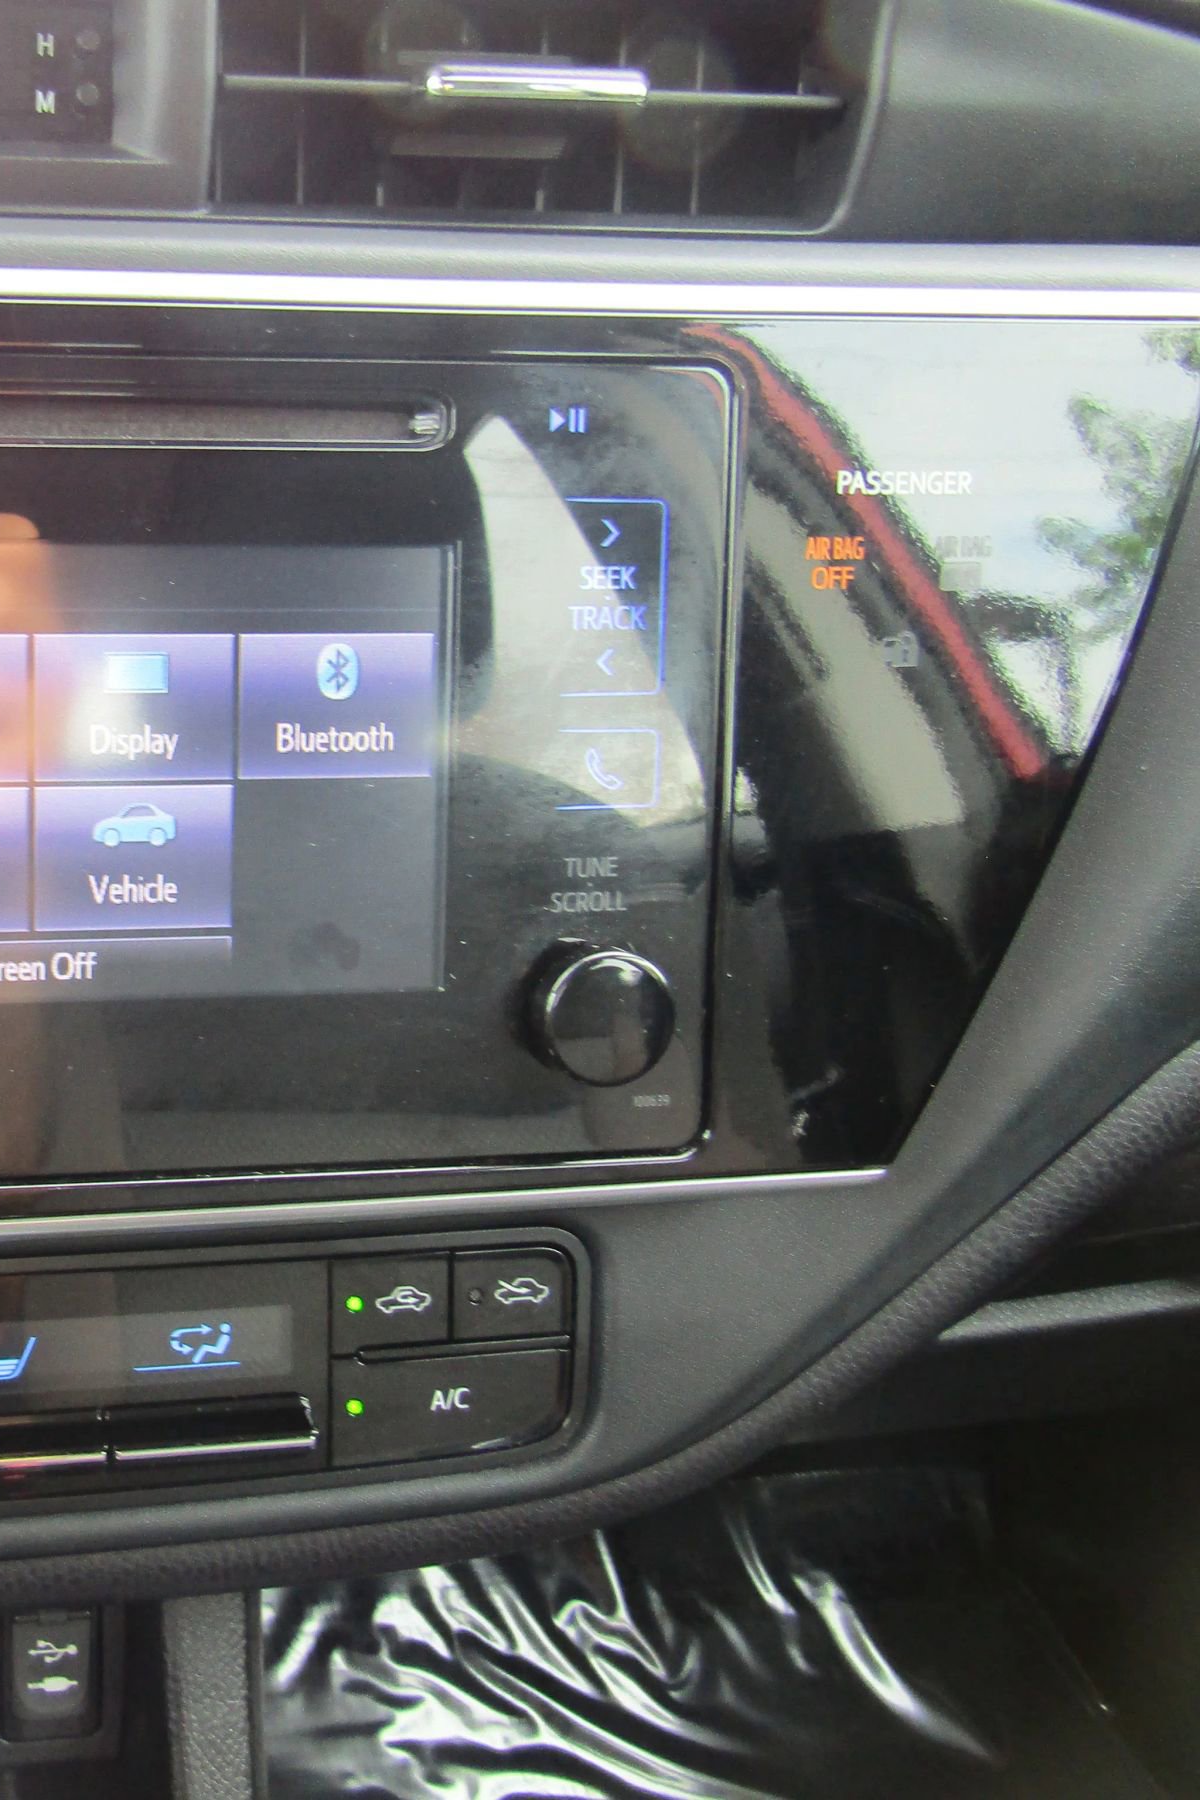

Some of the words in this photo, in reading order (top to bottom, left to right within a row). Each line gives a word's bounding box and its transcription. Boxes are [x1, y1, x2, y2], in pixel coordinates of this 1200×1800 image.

[36, 32, 55, 57] H
[36, 90, 56, 115] M
[836, 470, 973, 496] PASSENGER
[805, 537, 831, 560] AIR
[833, 536, 865, 560] BAG
[579, 565, 637, 590] SEEK
[811, 566, 855, 590] OFF
[568, 605, 648, 630] TRACK
[89, 724, 179, 760] Display
[275, 722, 395, 754] Bluetooth
[563, 856, 619, 879] TUNE
[88, 873, 179, 904] Vehicle
[550, 890, 628, 913] SCROLL
[50, 951, 98, 981] Off
[430, 1387, 471, 1412] A/C
